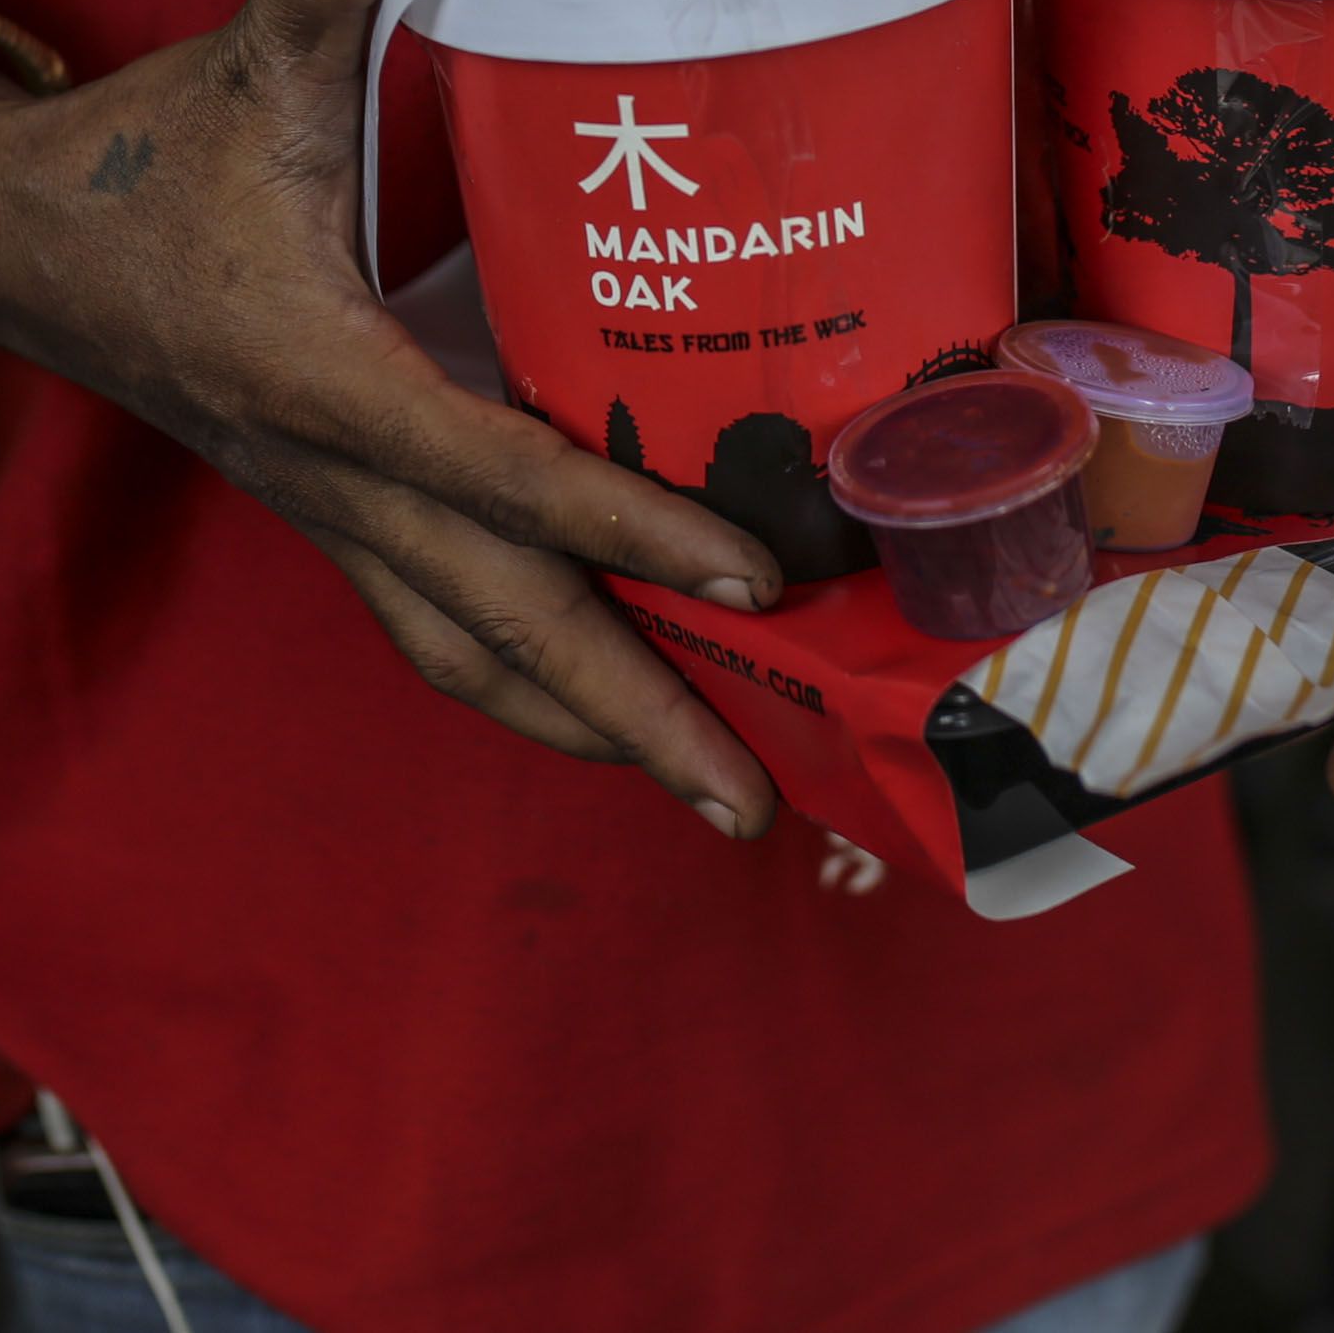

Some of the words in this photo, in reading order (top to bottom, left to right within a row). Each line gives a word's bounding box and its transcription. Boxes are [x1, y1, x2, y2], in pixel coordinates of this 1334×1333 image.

[584, 201, 866, 265] MANDARIN
[590, 270, 699, 312] OAK
[600, 327, 675, 353] TALES
[681, 330, 751, 353] FROM
[758, 323, 808, 349] THE
[813, 309, 867, 341] WOK
